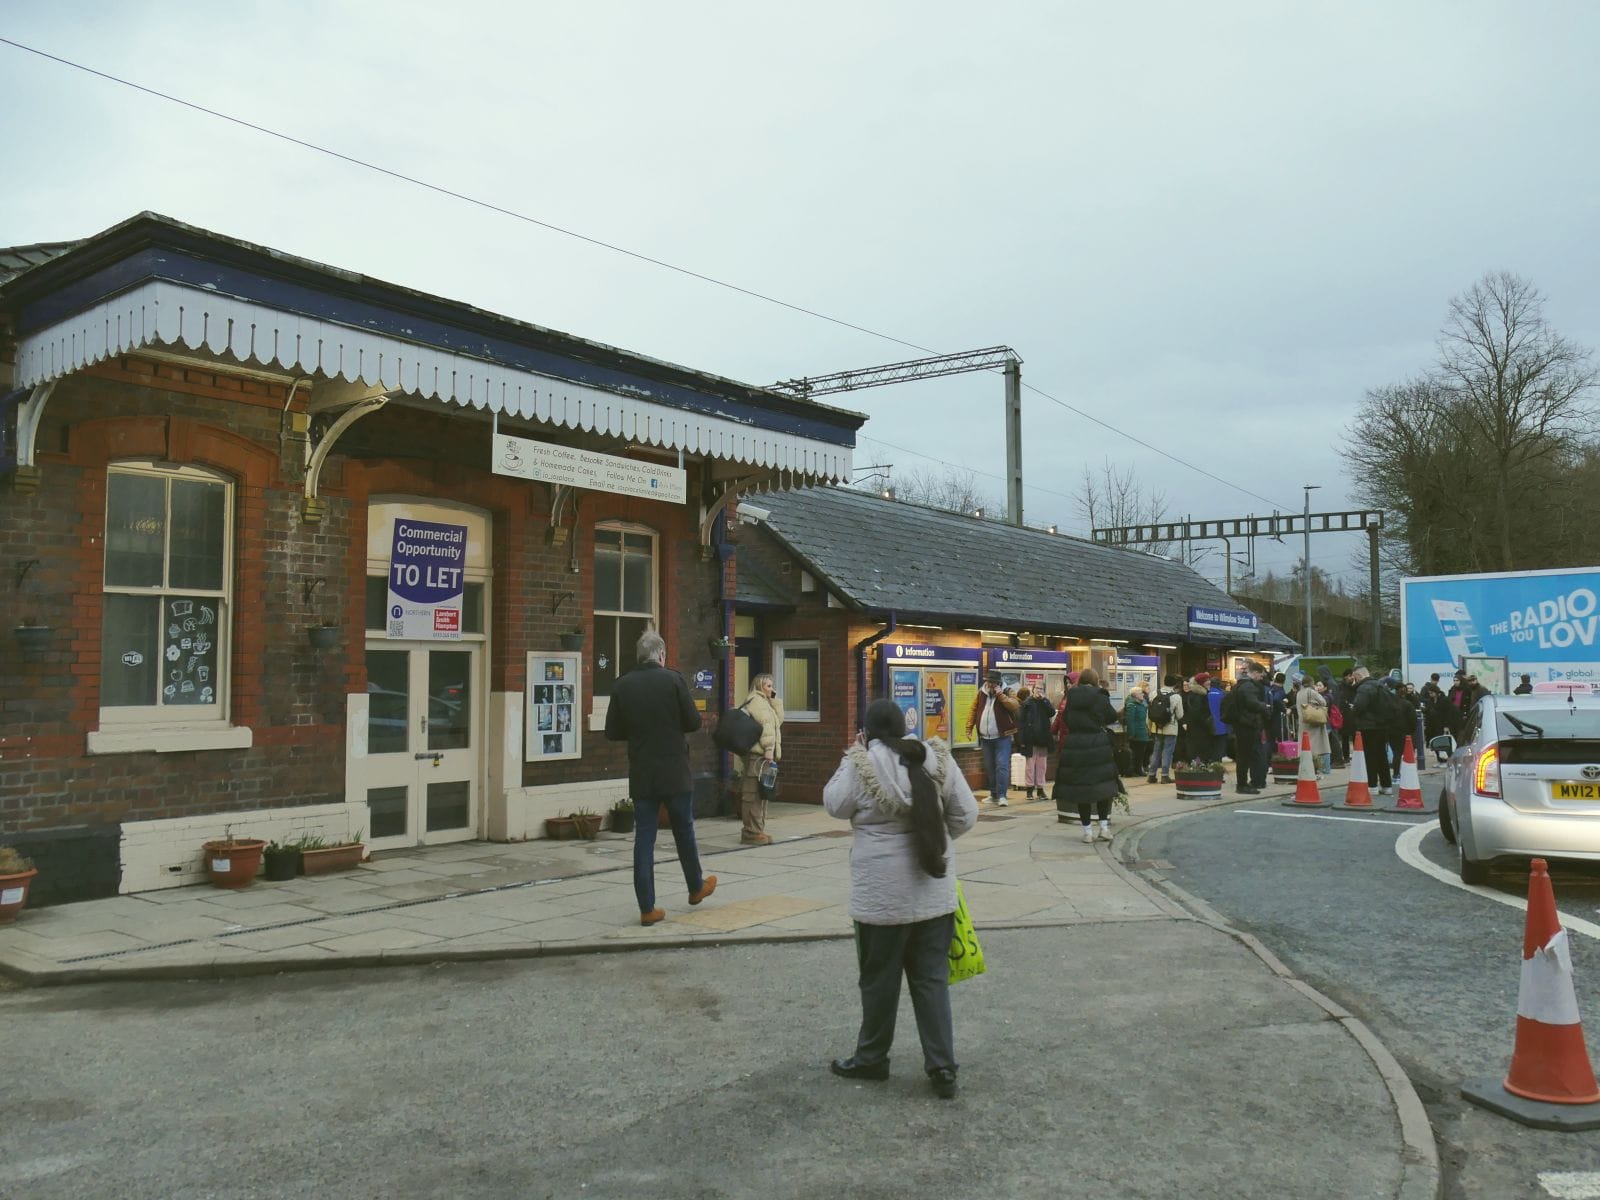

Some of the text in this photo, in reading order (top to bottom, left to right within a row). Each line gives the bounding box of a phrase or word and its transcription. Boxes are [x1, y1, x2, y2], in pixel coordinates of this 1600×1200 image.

[533, 446, 550, 456] Fresh
[580, 454, 603, 466] Bespoke
[642, 466, 656, 475] Cold
[541, 460, 575, 472] Homemade
[578, 466, 597, 477] Cakes
[590, 479, 605, 488] Email
[399, 525, 463, 542] Commercial
[397, 541, 461, 560] Opportunity
[394, 564, 461, 588] TO LET
[1196, 610, 1249, 624] Welcome to Wilmslow Station
[1490, 588, 1596, 635] THE RADIO
[1510, 615, 1600, 648] YOU LOV
[905, 648, 935, 657] Information
[1010, 652, 1032, 661] Information
[1565, 669, 1593, 679] global
[1561, 785, 1594, 797] MV12
